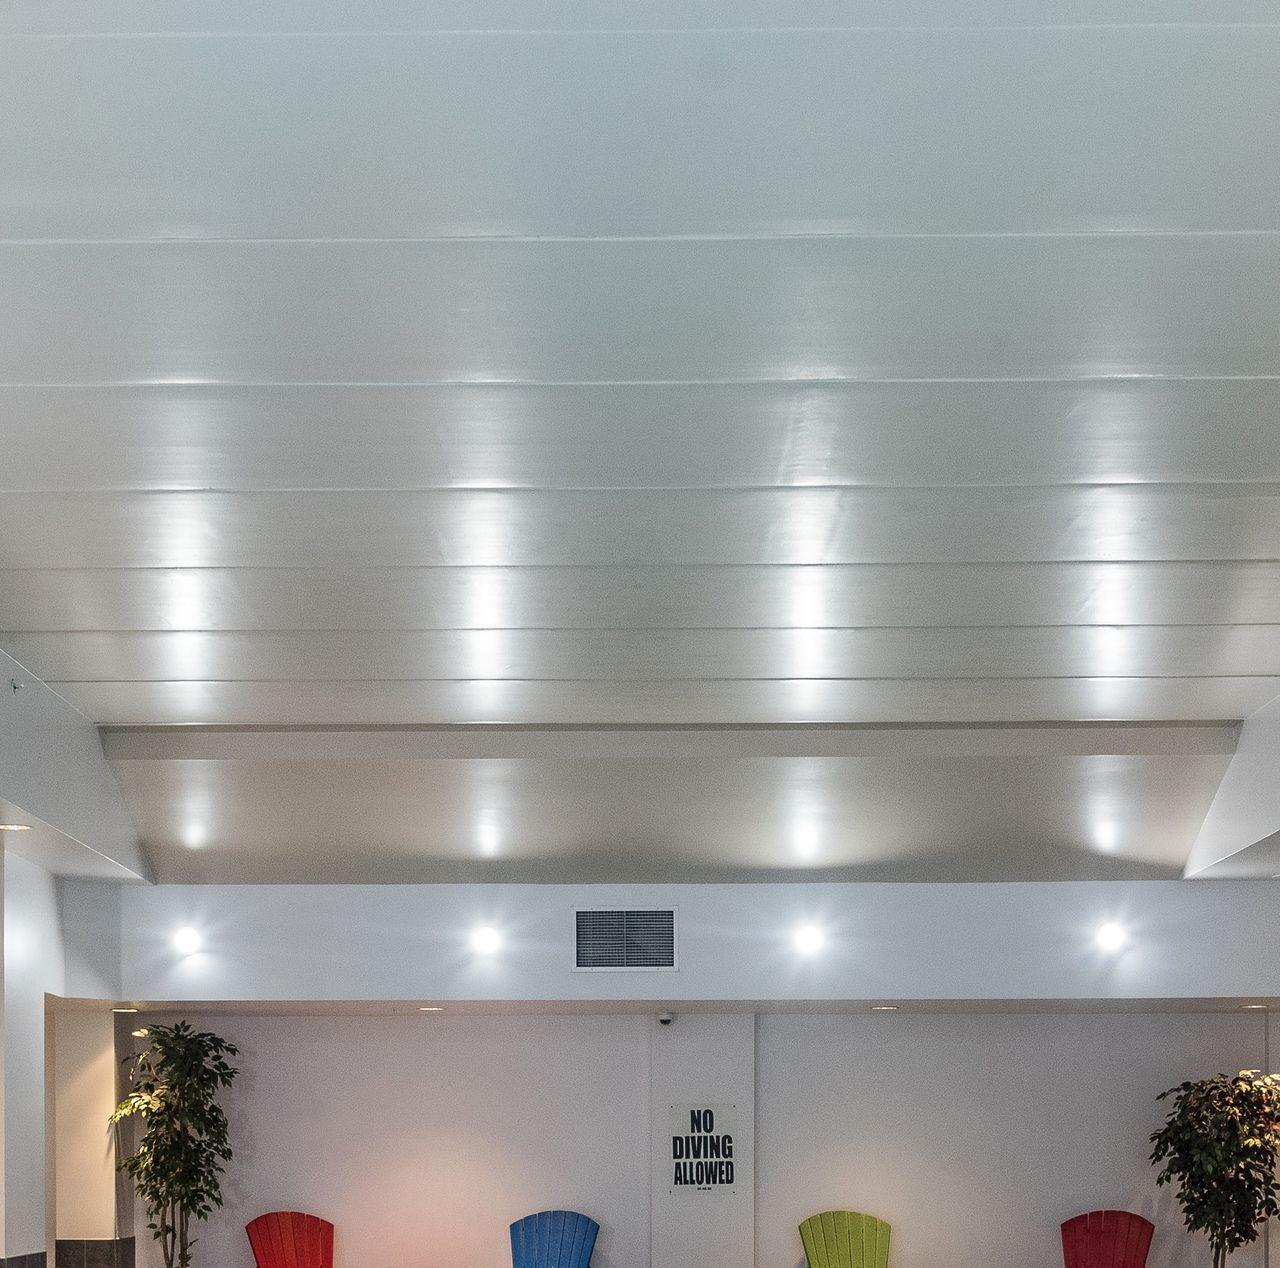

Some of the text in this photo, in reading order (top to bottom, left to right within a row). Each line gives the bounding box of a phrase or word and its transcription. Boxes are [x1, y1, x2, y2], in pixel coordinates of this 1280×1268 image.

[690, 1109, 714, 1133] NO
[672, 1135, 733, 1159] DIVING
[674, 1161, 734, 1185] ALLOWED
